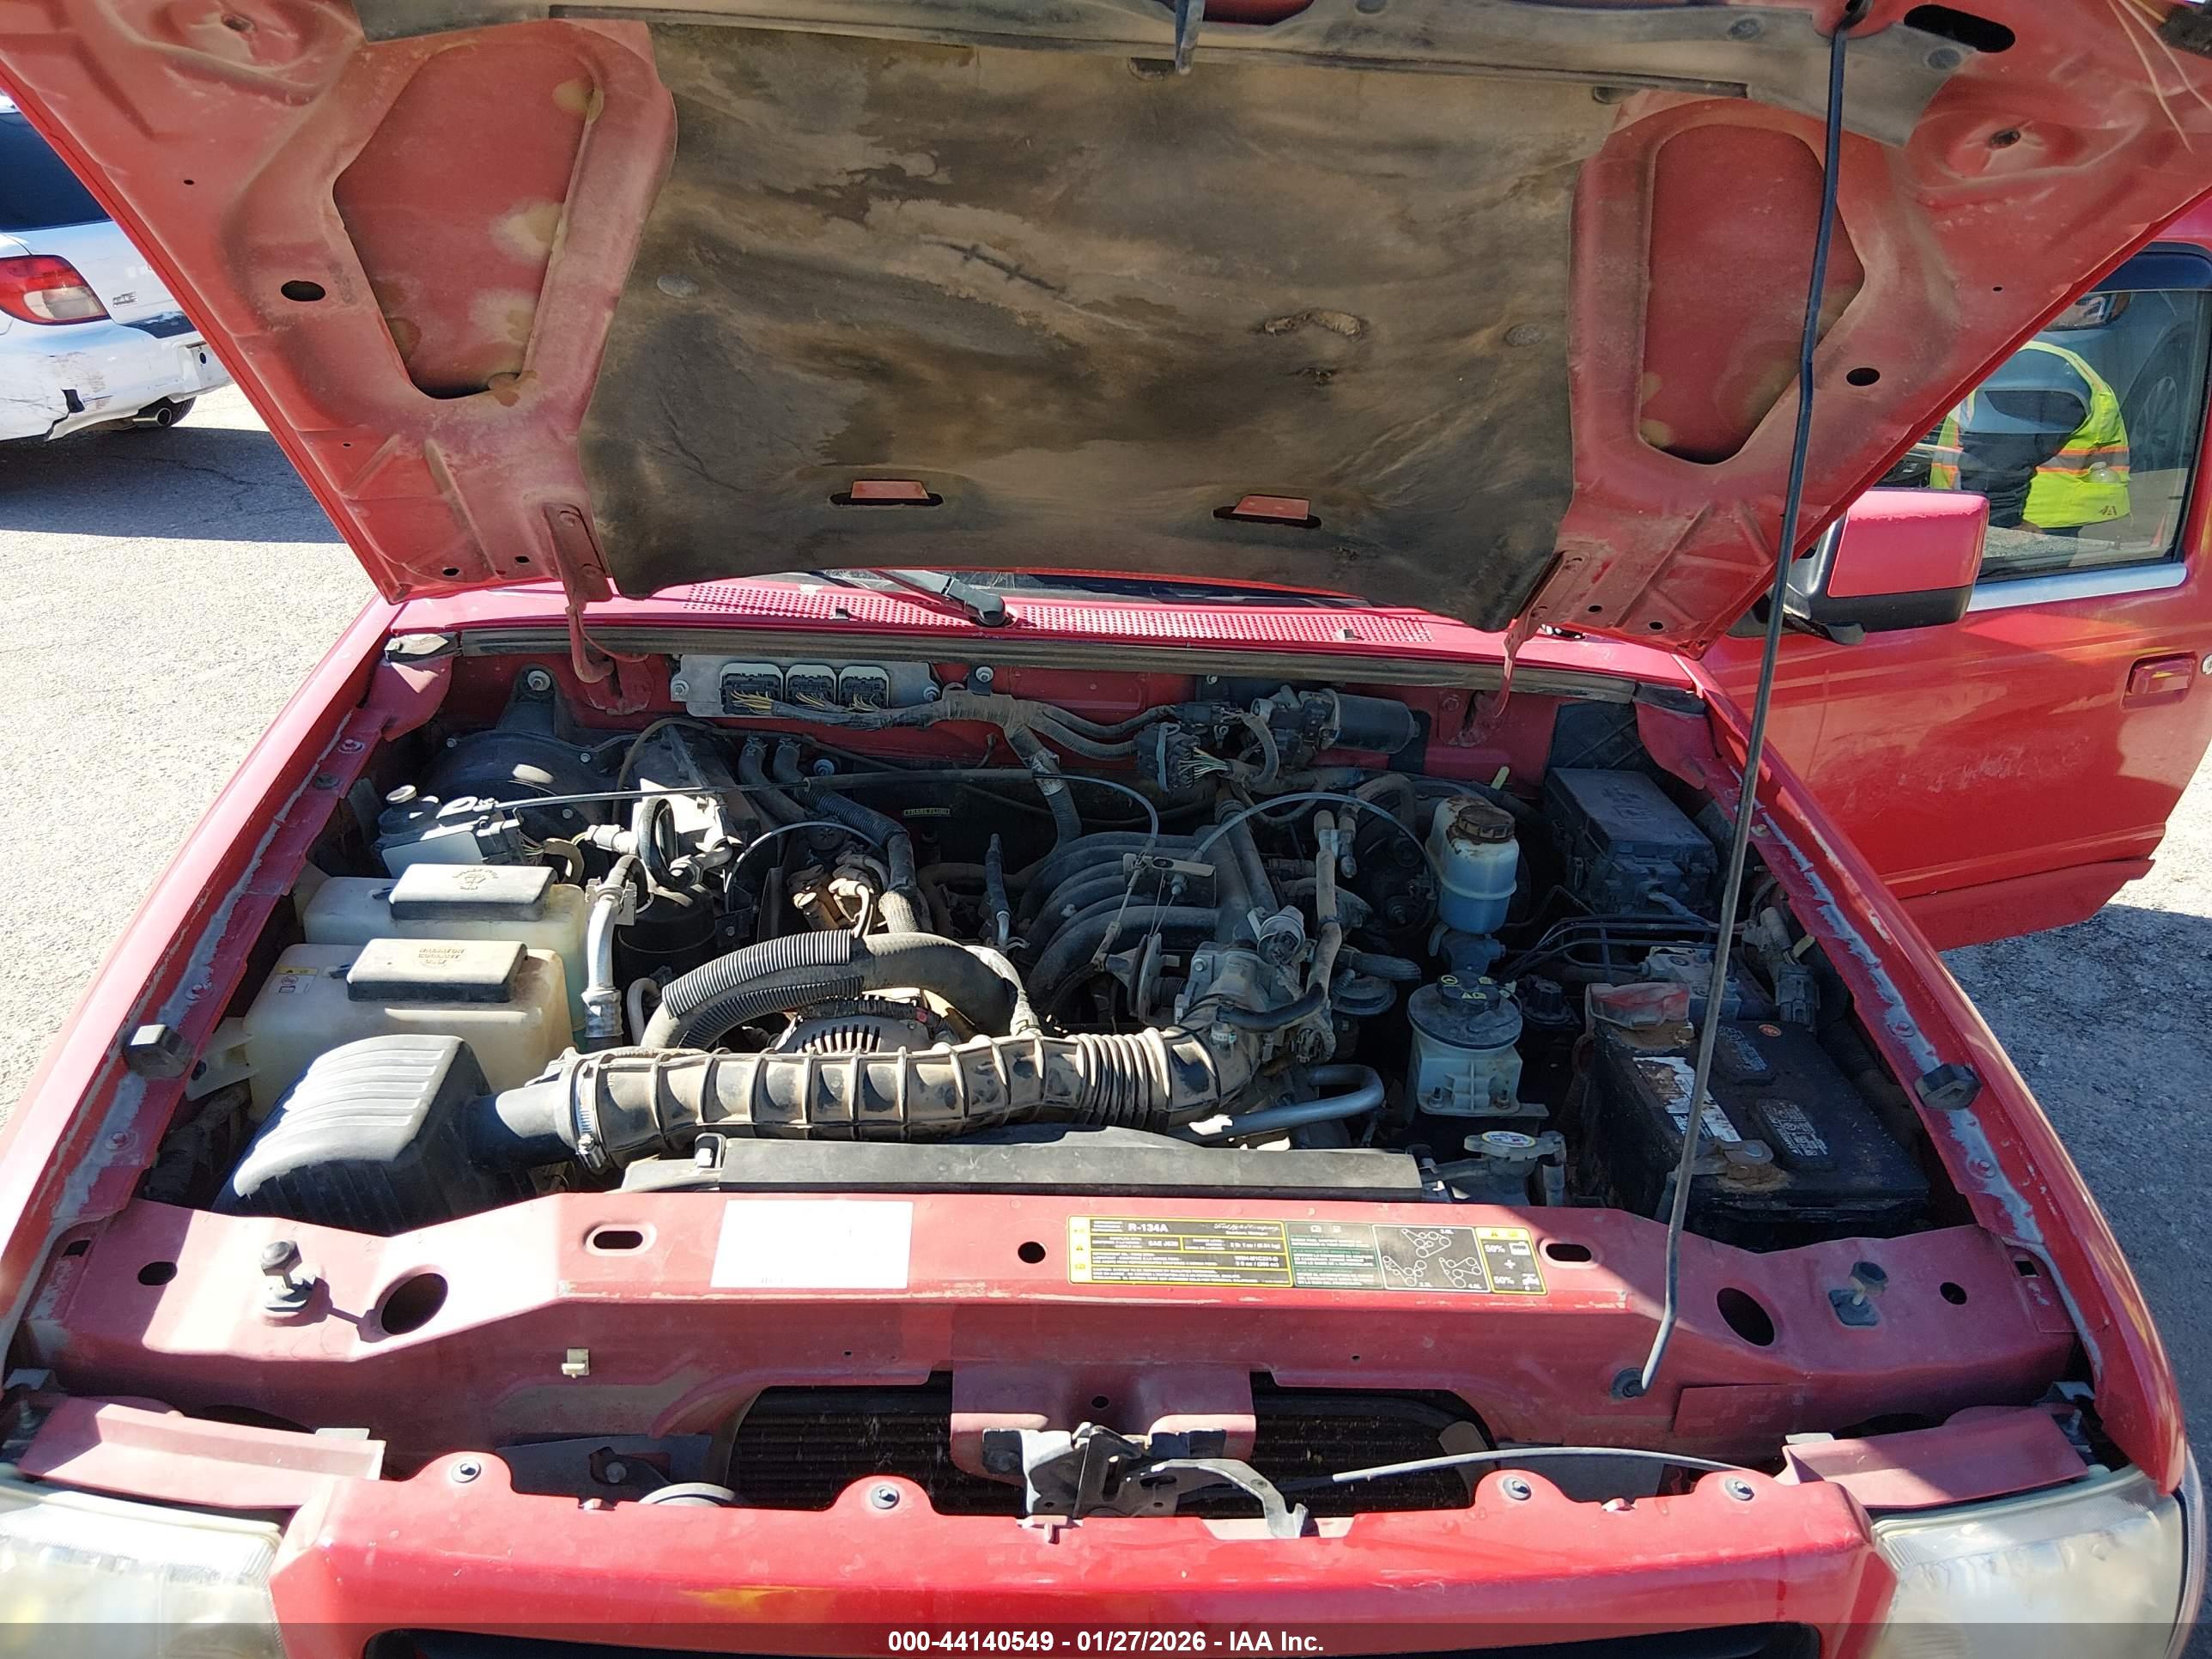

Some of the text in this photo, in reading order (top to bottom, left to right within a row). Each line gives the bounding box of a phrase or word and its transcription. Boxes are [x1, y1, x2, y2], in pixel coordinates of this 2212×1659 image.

[1127, 1223, 1169, 1233] R-134A
[1485, 1244, 1506, 1254] 50%
[1493, 1276, 1516, 1285] 50%
